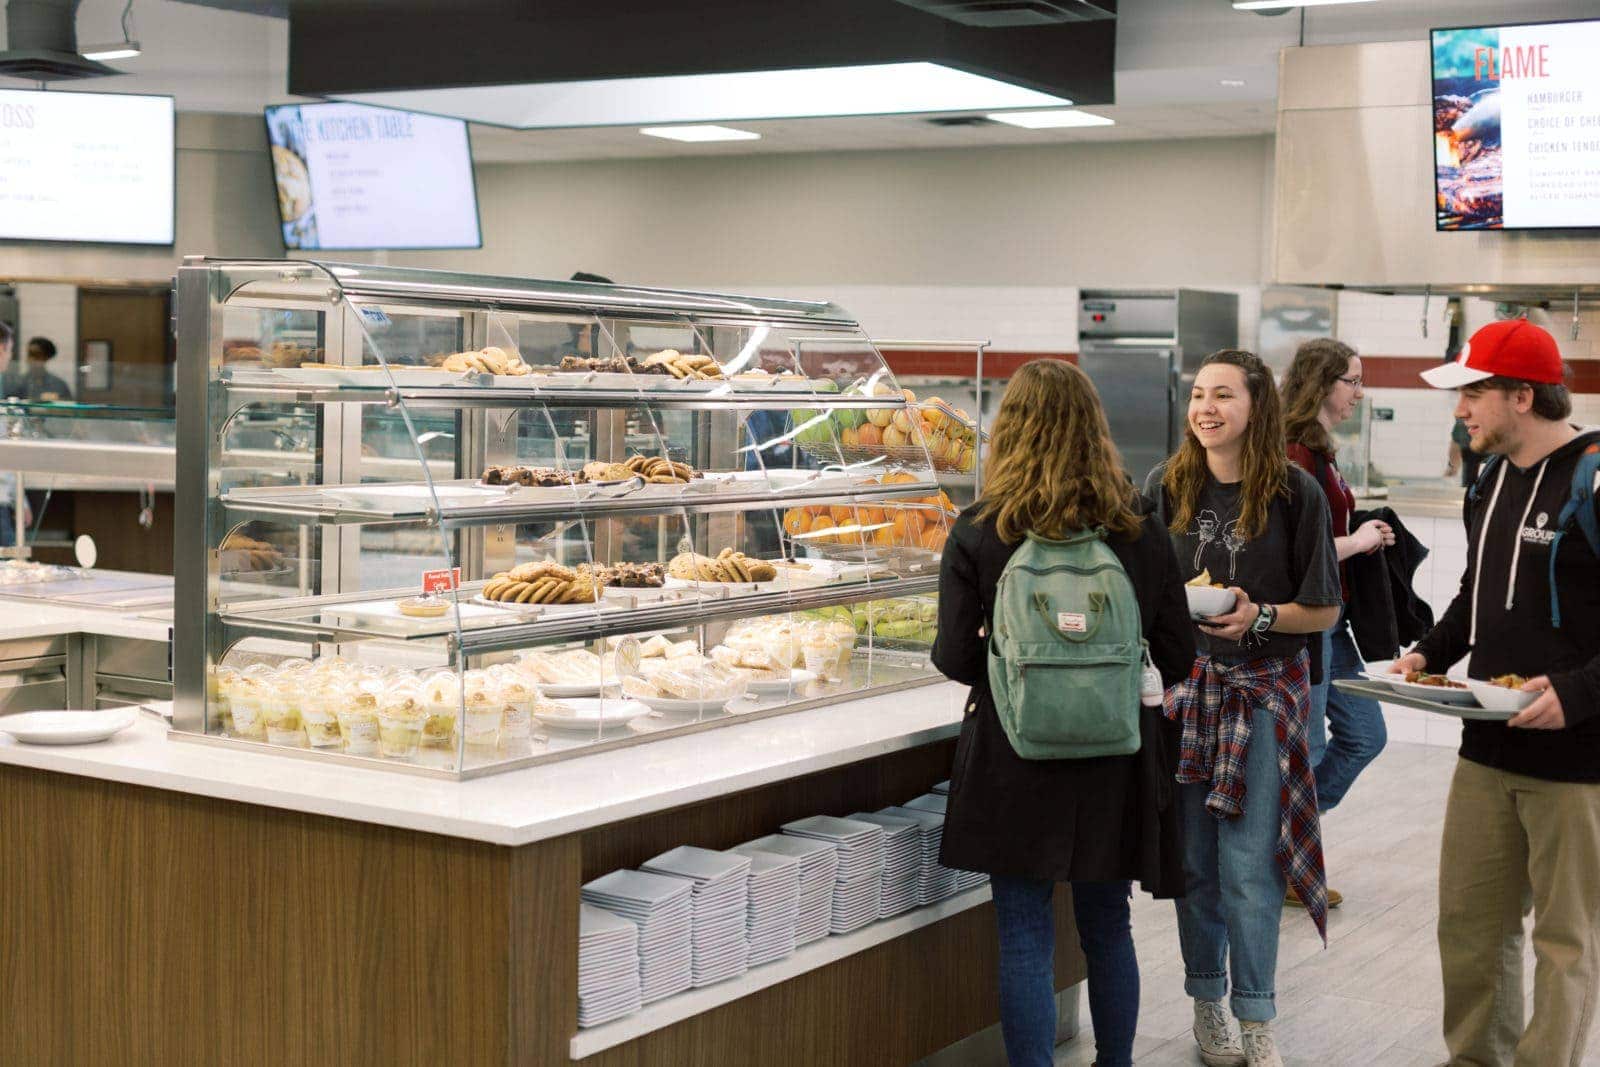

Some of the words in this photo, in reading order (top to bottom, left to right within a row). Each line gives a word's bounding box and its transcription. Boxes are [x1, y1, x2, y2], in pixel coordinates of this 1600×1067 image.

[1474, 45, 1550, 81] FLAME
[1527, 91, 1584, 105] HAMBURGER
[0, 103, 35, 129] OSS
[1528, 116, 1560, 129] CHOICE
[1564, 115, 1575, 128] OF
[317, 115, 373, 142] KITCHEN
[377, 114, 415, 138] TABLE
[1528, 142, 1568, 154] CHICKEN
